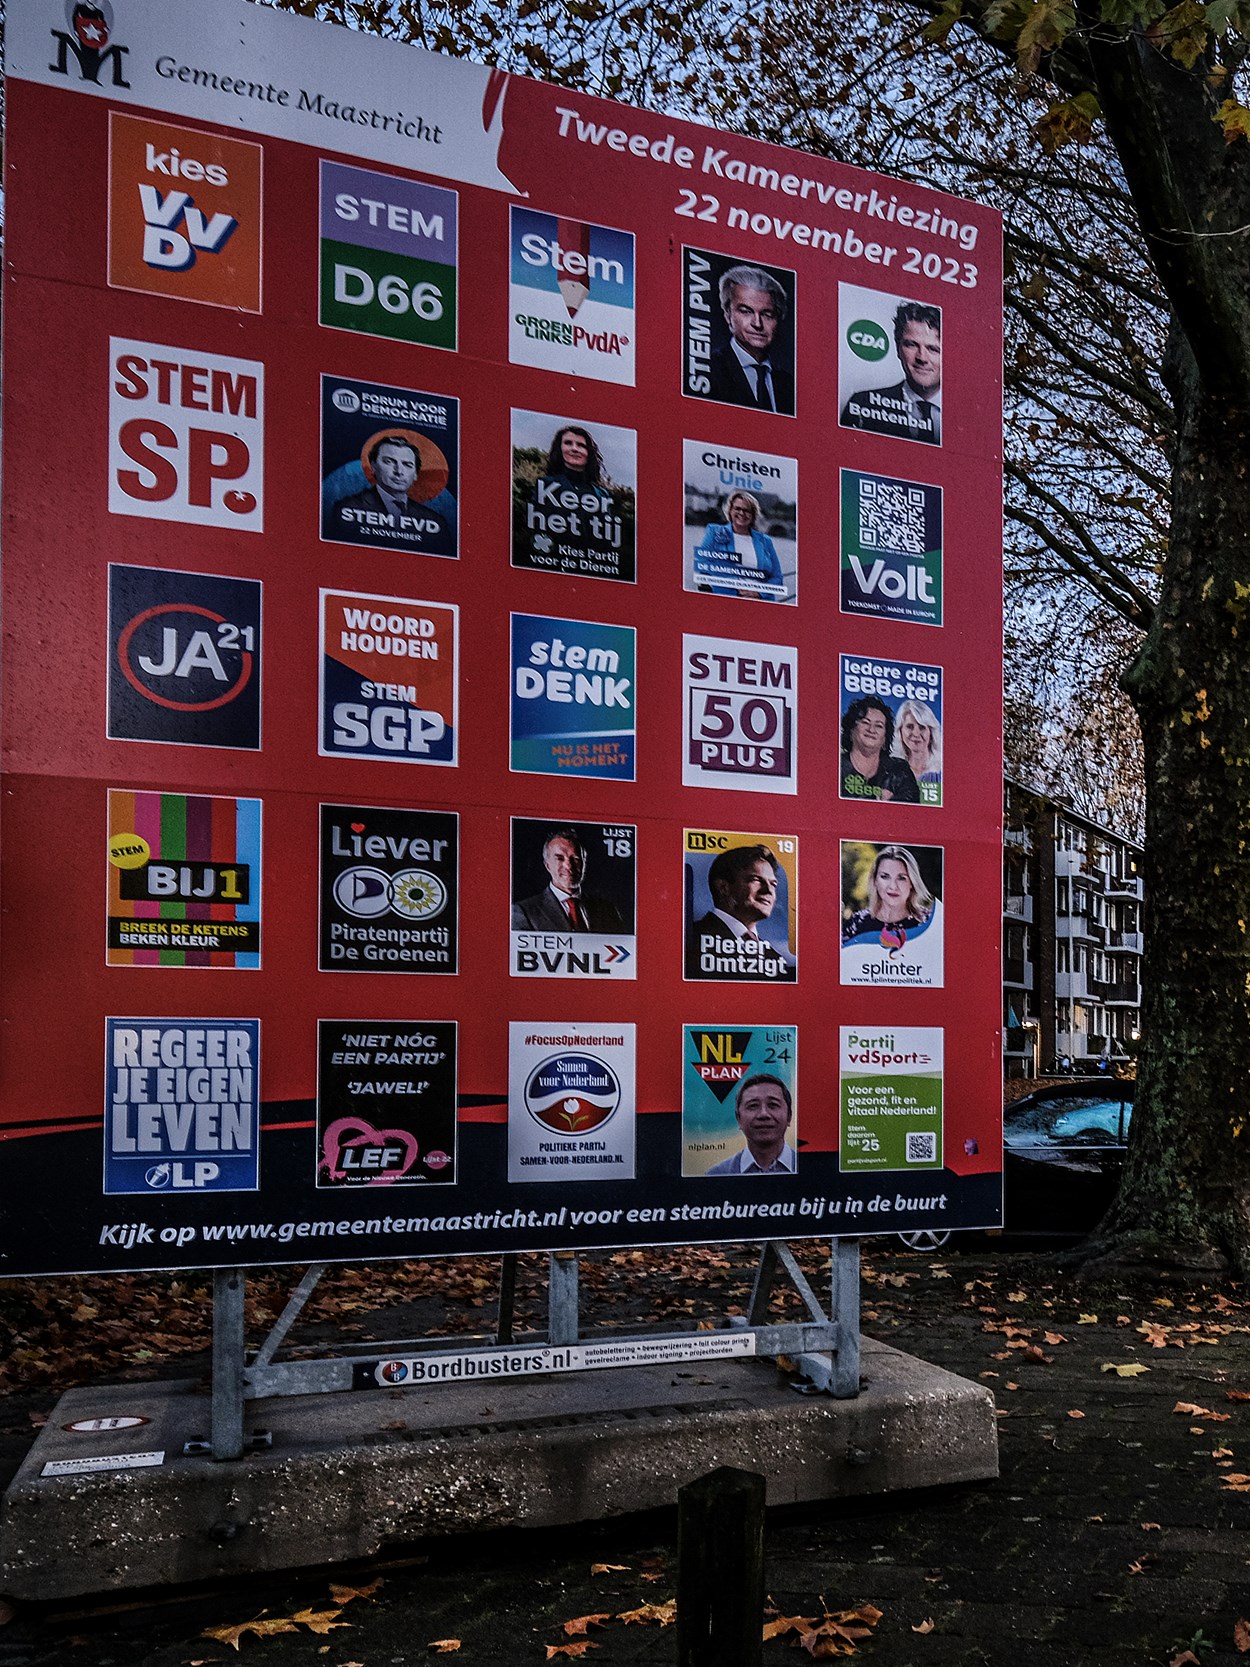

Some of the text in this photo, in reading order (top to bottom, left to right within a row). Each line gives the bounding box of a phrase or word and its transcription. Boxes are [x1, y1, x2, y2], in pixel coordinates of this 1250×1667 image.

[155, 55, 443, 145] Gemeente Maastricht
[145, 143, 229, 187] kies
[555, 107, 979, 250] Tweede Kamerverkiezing
[334, 193, 444, 242] STEM
[674, 189, 979, 289] 22 november 2023
[520, 233, 625, 284] Stem
[334, 263, 443, 321] D66
[515, 314, 572, 335] GROEN
[688, 252, 713, 394] STEM PVV
[525, 325, 621, 356] LINKS PvdA
[850, 331, 886, 351] CDA
[115, 355, 257, 419] STEM
[362, 392, 447, 416] FORUM VOOR
[362, 402, 447, 426] DEMOCRATIE
[869, 392, 914, 414] Henri
[849, 403, 933, 431] Bontenbal
[701, 452, 781, 479] Christen
[719, 470, 764, 491] Unie
[341, 507, 440, 534] STEM FVD
[527, 503, 623, 548] het tij
[372, 528, 423, 542] NOVEMBER
[530, 553, 620, 575] voor de Dieren
[558, 544, 620, 566] Kies Partij
[848, 554, 936, 604] Volt
[342, 607, 436, 638] WOORD
[341, 631, 439, 661] HOUDEN
[529, 638, 620, 674] stem
[689, 652, 792, 689] STEM
[844, 659, 939, 687] Iedere dag
[360, 681, 416, 703] STEM
[516, 666, 631, 709] DENK
[844, 674, 939, 702] BBBeter
[333, 702, 445, 753] SGP
[700, 695, 778, 743] 50
[576, 744, 589, 754] IS
[592, 743, 620, 754] HET
[701, 743, 775, 770] PLUS
[558, 753, 628, 767] MOMENT
[922, 789, 938, 801] 15
[331, 822, 449, 862] Liever
[603, 827, 633, 838] LIJST
[111, 844, 144, 859] STEM
[603, 839, 632, 858] 18
[147, 865, 243, 900] BIJ1
[119, 921, 249, 937] BREEK DE KETENS
[119, 933, 219, 947] BEKEN KLEUR
[330, 923, 450, 947] Piratenpartij
[517, 934, 573, 949] STEM
[700, 934, 771, 956] Pieter
[330, 944, 449, 963] De Groenen
[517, 951, 611, 975] BVNL
[700, 955, 787, 978] Omtzigt
[862, 960, 922, 978] splinter
[113, 1029, 251, 1068] REGEER
[394, 1031, 437, 1048] NÓG
[525, 1034, 624, 1047] #FocusOpNederland
[701, 1034, 743, 1063] NL
[765, 1031, 792, 1044] Lijst
[848, 1033, 895, 1052] Partij
[331, 1052, 371, 1066] EEN
[763, 1047, 792, 1064] 24
[848, 1050, 918, 1067] vdSport
[556, 1060, 588, 1074] Samen
[700, 1067, 743, 1080] PLAN
[112, 1068, 252, 1104] JE EIGEN
[539, 1074, 609, 1087] voor Nederland
[847, 1086, 895, 1095] Voor een
[847, 1096, 889, 1107] gezond,
[891, 1095, 902, 1104] fit
[847, 1106, 937, 1116] vitaal Nederland!
[112, 1103, 251, 1152] LEVEN
[539, 1141, 606, 1152] POLITIEKE PARTIJ
[688, 1142, 726, 1152] nlplan.nl
[862, 1139, 880, 1151] 25
[342, 1148, 402, 1168] LEF
[520, 1154, 624, 1166] SAMEN-VOOR-NEDERLAND.NL
[172, 1162, 219, 1187] LP
[99, 1193, 947, 1249] Kijk op www.gemeentemaastricht.nl voor een stembureau bij u in de buurt
